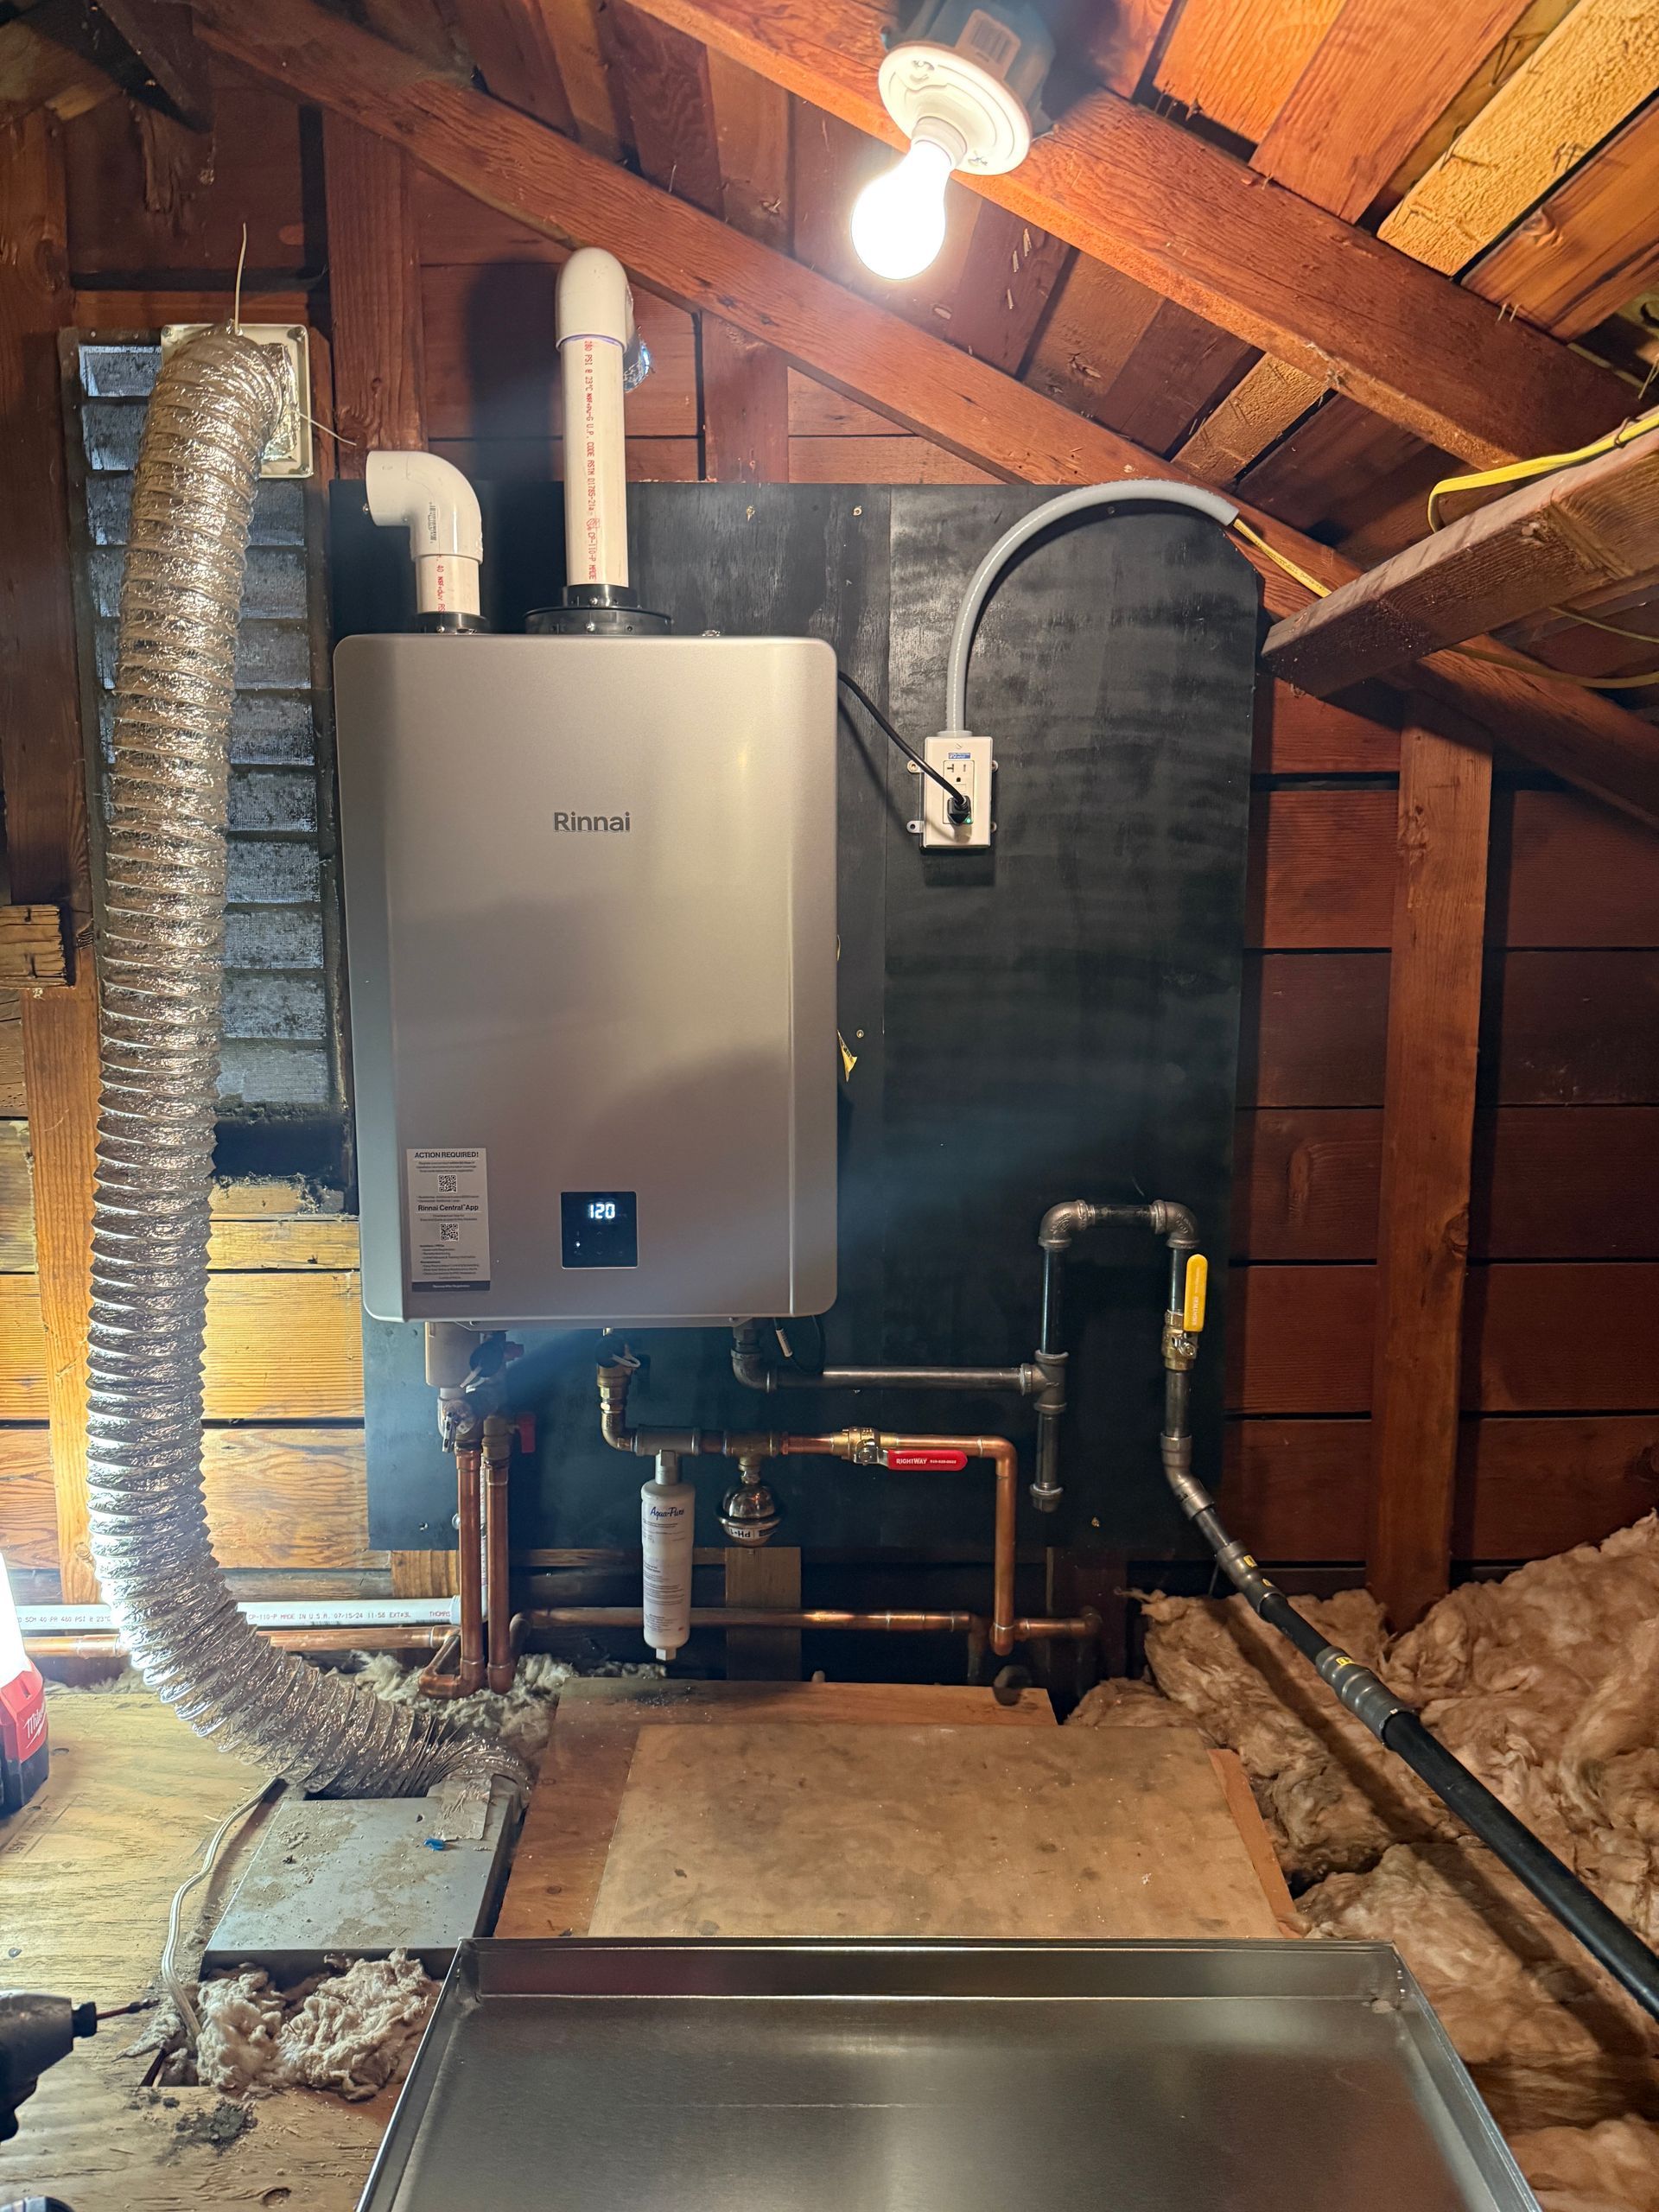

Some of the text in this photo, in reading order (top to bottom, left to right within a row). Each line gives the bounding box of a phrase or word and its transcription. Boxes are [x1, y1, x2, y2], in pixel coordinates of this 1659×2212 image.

[584, 354, 593, 365] PSI
[587, 442, 595, 457] CODE
[587, 460, 595, 475] ASTM
[436, 564, 444, 573] 40
[588, 564, 597, 580] MADE
[437, 603, 446, 613] AS
[553, 810, 631, 831] Rinnai
[589, 1202, 616, 1219] 120
